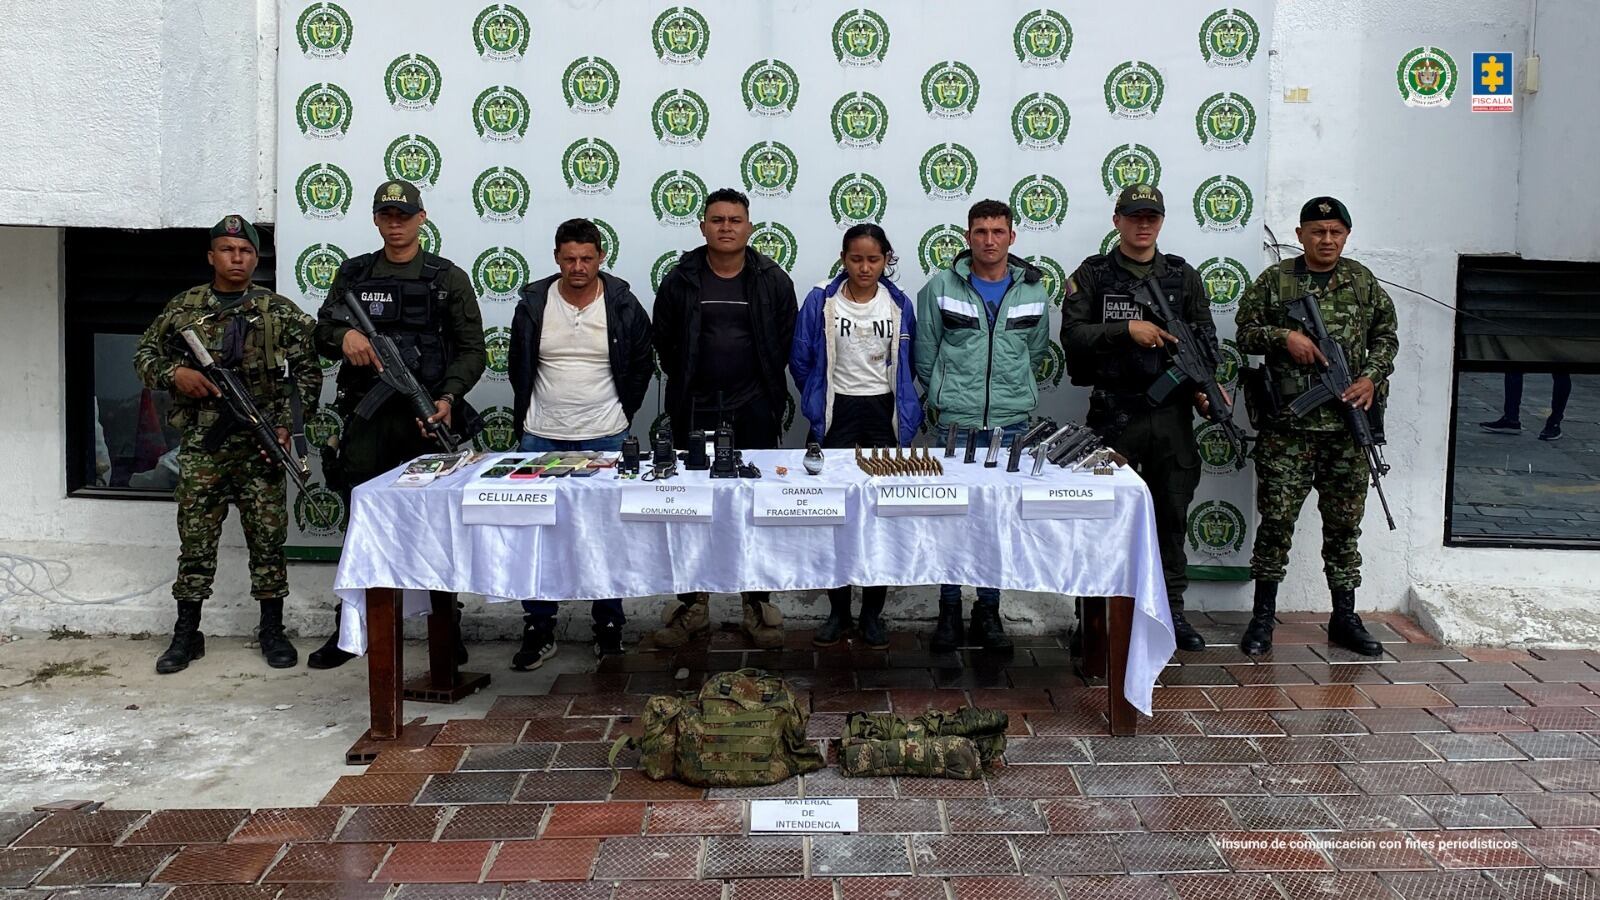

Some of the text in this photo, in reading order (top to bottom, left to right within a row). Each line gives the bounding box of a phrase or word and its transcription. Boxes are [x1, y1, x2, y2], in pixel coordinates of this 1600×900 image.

[381, 194, 408, 202] GAULA
[361, 292, 393, 302] GAULA
[1106, 302, 1139, 311] GAULA
[1105, 310, 1140, 320] POLICIA
[478, 492, 548, 503] CELULARES
[880, 486, 957, 499] MUNICION
[1048, 488, 1094, 498] PISTOLAS
[801, 809, 814, 817] DE
[775, 821, 840, 829] INTENDENCIA
